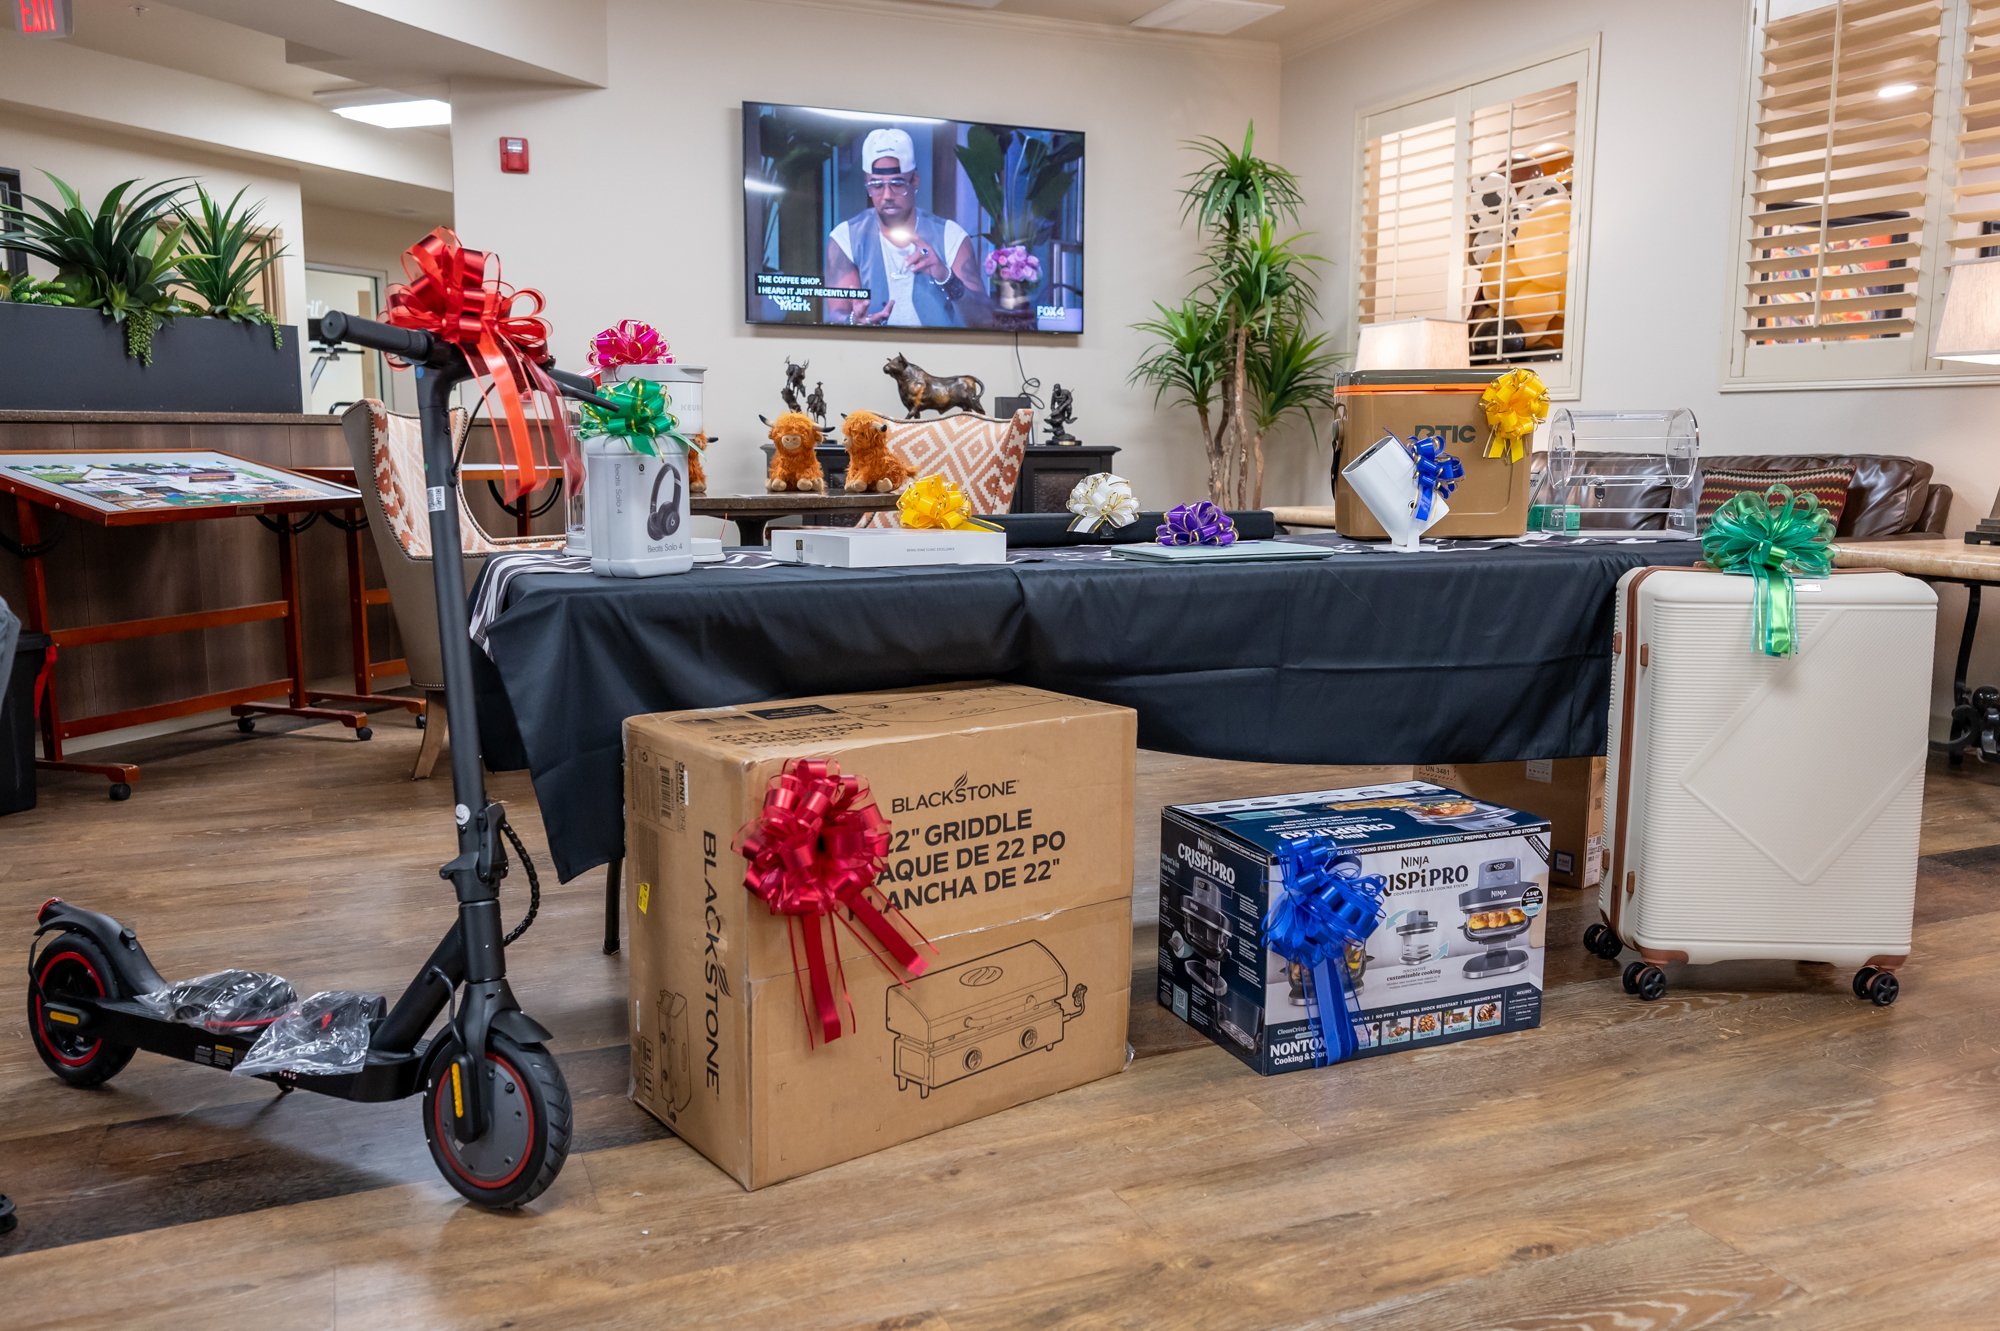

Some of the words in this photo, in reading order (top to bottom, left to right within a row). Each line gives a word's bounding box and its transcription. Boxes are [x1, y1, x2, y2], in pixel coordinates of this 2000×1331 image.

[758, 275, 772, 284] THE
[773, 276, 799, 285] COFFEE
[800, 277, 822, 286] SHOP.
[762, 287, 786, 295] HEARD
[787, 288, 795, 296] IT
[795, 288, 813, 296] JUST
[814, 289, 849, 298] RECENTLY
[849, 290, 857, 298] IS
[857, 290, 868, 298] NO
[780, 299, 811, 312] Mark
[1414, 424, 1476, 444] RTIC
[615, 487, 623, 507] Solo
[648, 544, 663, 553] Beats
[664, 543, 677, 552] Solo
[678, 543, 683, 551] 4
[891, 779, 1018, 814] BLACKSTONE
[925, 808, 1032, 846] GRIDDLE
[1198, 838, 1214, 855] NINJA
[1337, 848, 1353, 856] GLASS
[1354, 846, 1377, 854] COOKING
[1377, 844, 1396, 852] SYSTEM
[1397, 842, 1420, 850] DESIGNED
[1432, 836, 1464, 845] NONTOXIC
[1521, 826, 1541, 834] STORING
[875, 852, 949, 886] AQUE
[956, 844, 989, 870] DE
[996, 837, 1025, 862] 22
[1032, 830, 1066, 855] PO
[1401, 855, 1430, 869] NINJA
[984, 866, 1017, 892] DE
[1023, 858, 1061, 884] 22"
[1212, 859, 1235, 884] PRO
[1379, 868, 1427, 897] RISPi
[1429, 864, 1469, 887] PRO
[1491, 889, 1507, 898] NINJA
[703, 830, 721, 1095] BLACKSTONE
[1387, 970, 1421, 982] customizable
[1421, 968, 1442, 976] cooking
[1400, 1007, 1420, 1015] THERMAL
[1436, 1001, 1458, 1009] RESISTANT
[1463, 996, 1491, 1005] DISHWASHER
[1277, 1026, 1307, 1036] CleanCrisp
[1270, 1036, 1326, 1058] NONTOX
[1274, 1054, 1304, 1066] Cooking
